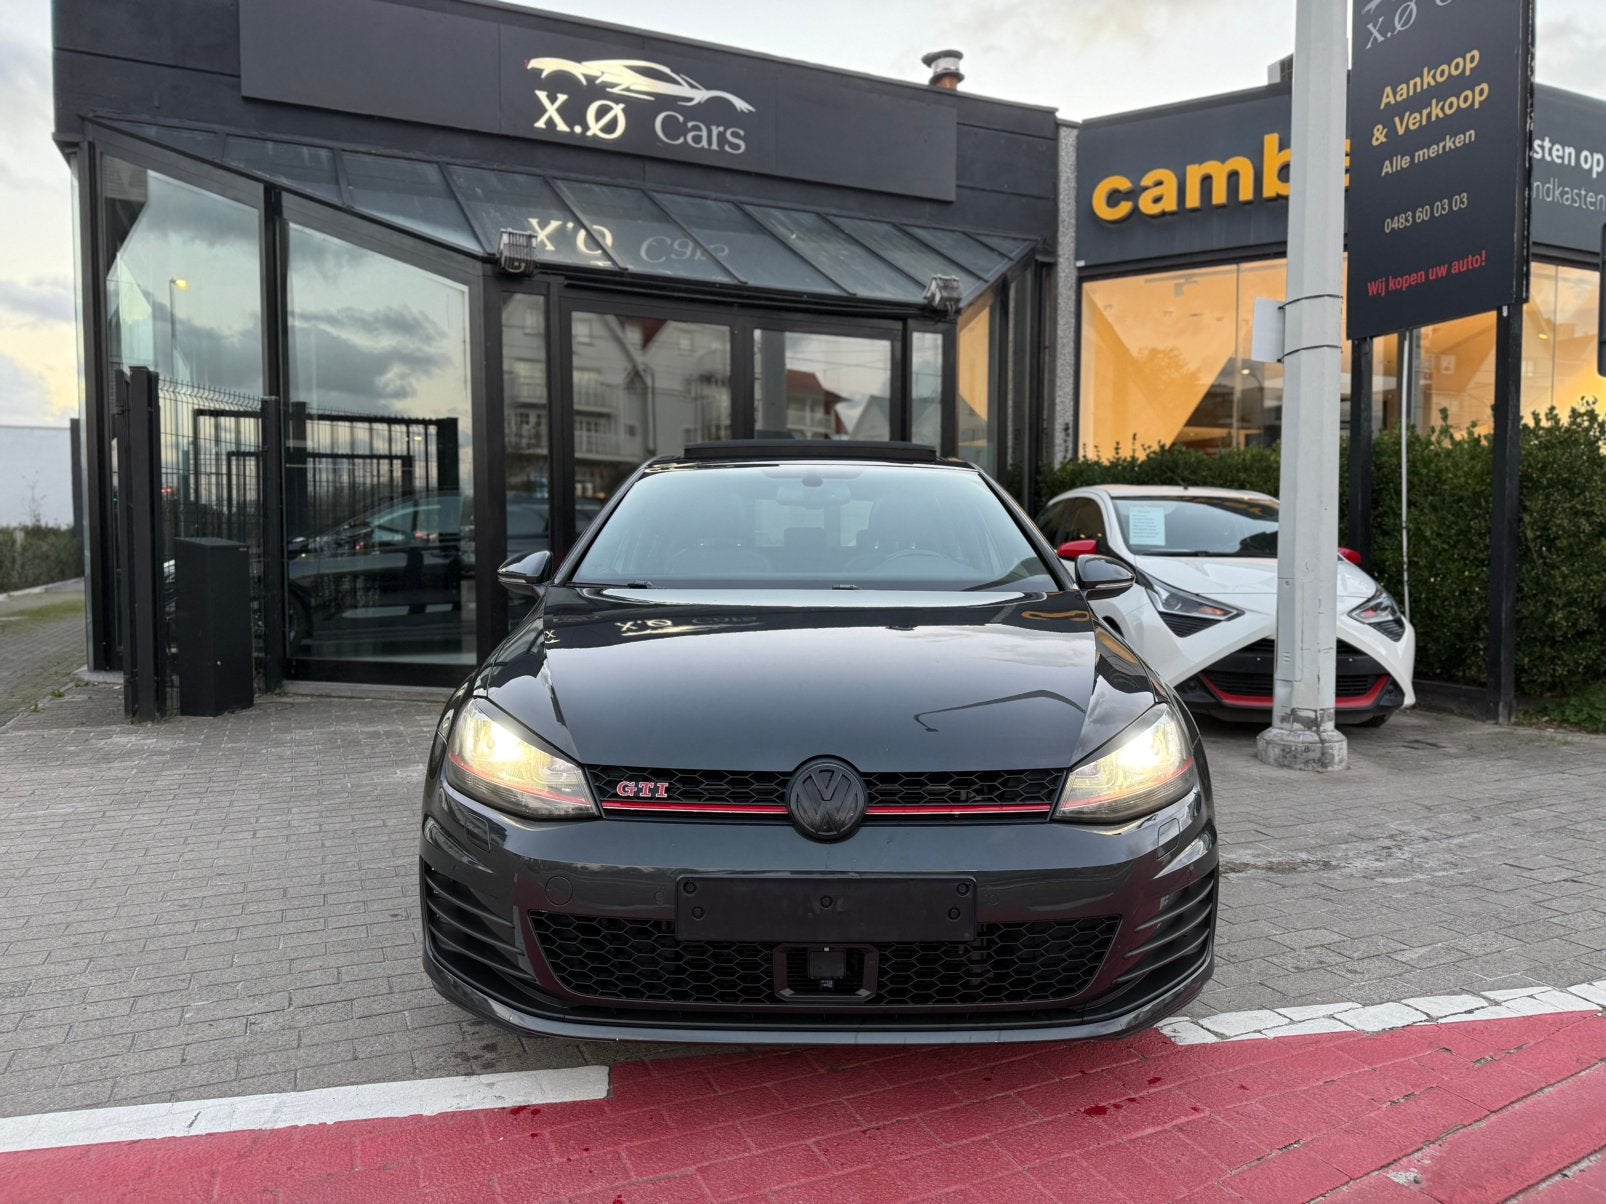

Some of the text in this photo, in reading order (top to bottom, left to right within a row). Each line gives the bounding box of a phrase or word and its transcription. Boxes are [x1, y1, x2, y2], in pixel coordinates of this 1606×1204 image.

[1380, 49, 1480, 110] Aankoop
[654, 110, 746, 154] Cars
[1371, 82, 1489, 147] & Verkoop
[1381, 129, 1475, 177] Alle merken
[1533, 136, 1605, 179] sten op
[1092, 132, 1350, 221] camb
[1533, 177, 1606, 211] ndkasten
[1384, 192, 1468, 233] 0483 60 03 03
[1367, 249, 1486, 296] Wij kopen uw auto!
[617, 780, 669, 798] GTI
